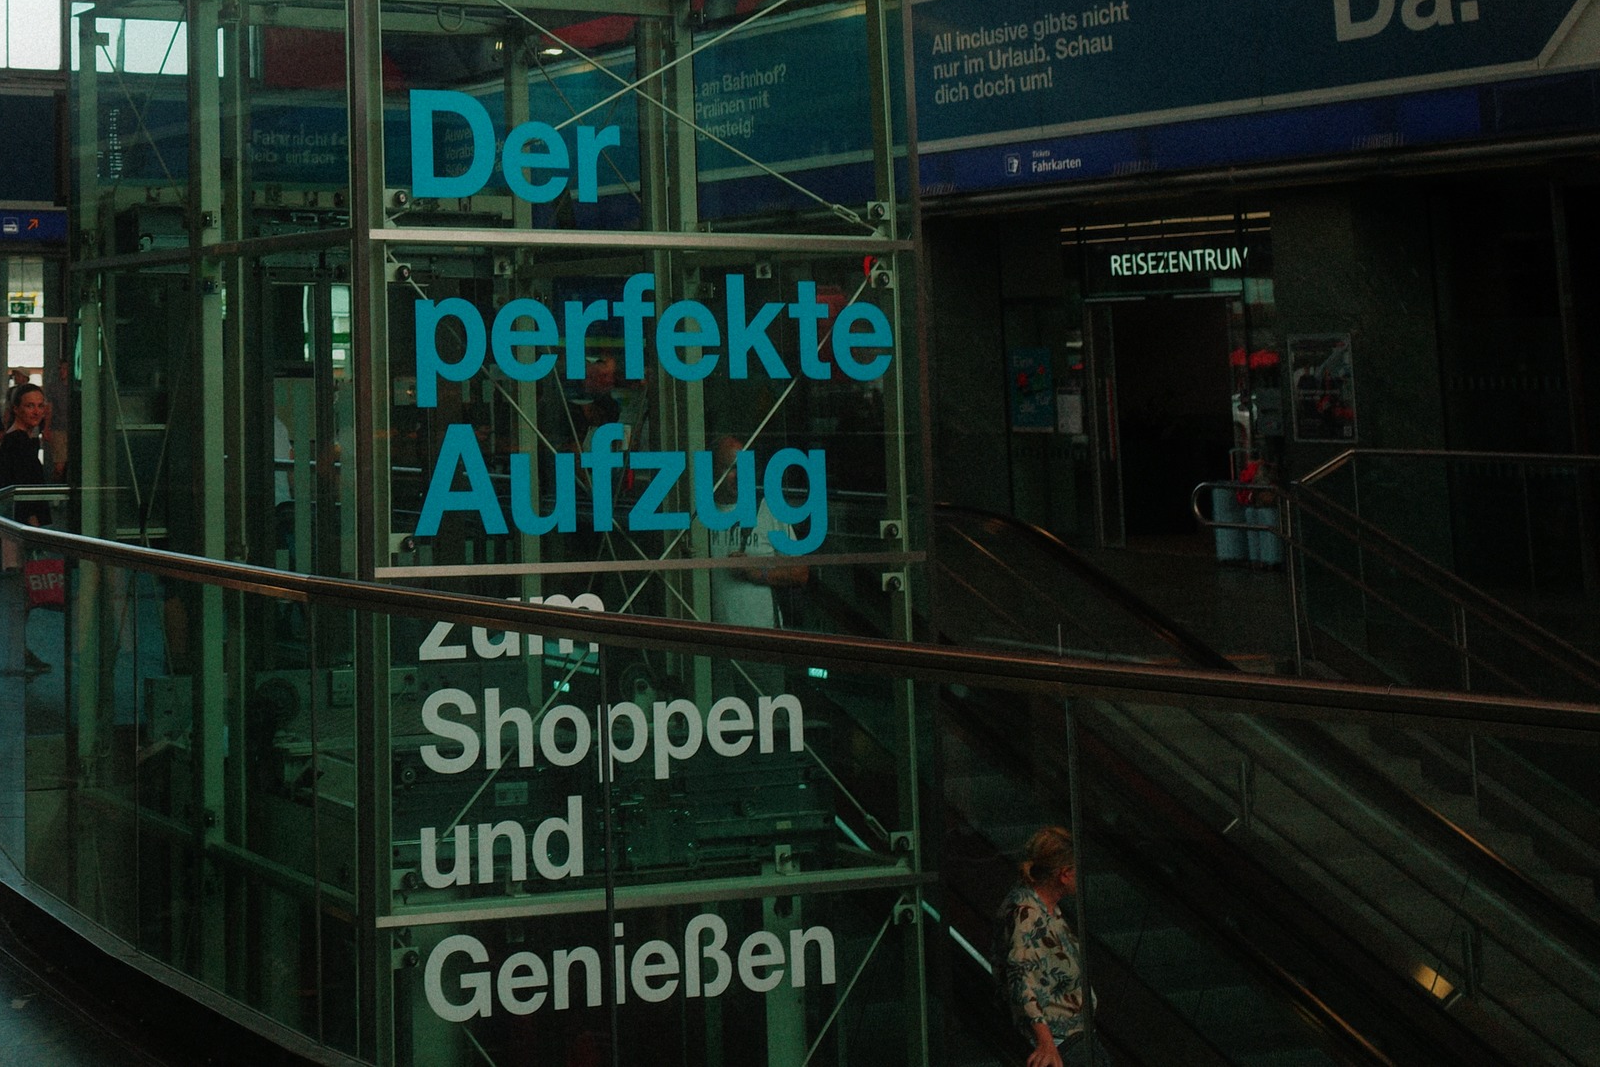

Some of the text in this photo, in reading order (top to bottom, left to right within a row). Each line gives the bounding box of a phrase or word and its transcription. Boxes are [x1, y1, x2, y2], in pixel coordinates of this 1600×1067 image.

[932, 0, 1130, 55] All inclusive gibts nicht
[701, 63, 787, 97] am Bahnhof?
[933, 34, 1114, 81] nur im Urlaub. Schau
[696, 90, 771, 119] Pralinen mit
[935, 66, 1053, 105] dich doch um!
[408, 88, 622, 205] Der
[1032, 158, 1082, 173] Fahrkarten
[1110, 246, 1249, 277] REISEZENTRUM
[415, 273, 895, 409] perfekte
[415, 423, 829, 558] Aufzug
[419, 686, 806, 783] Shoppen
[419, 794, 585, 890] und
[423, 912, 837, 1024] Genießen
